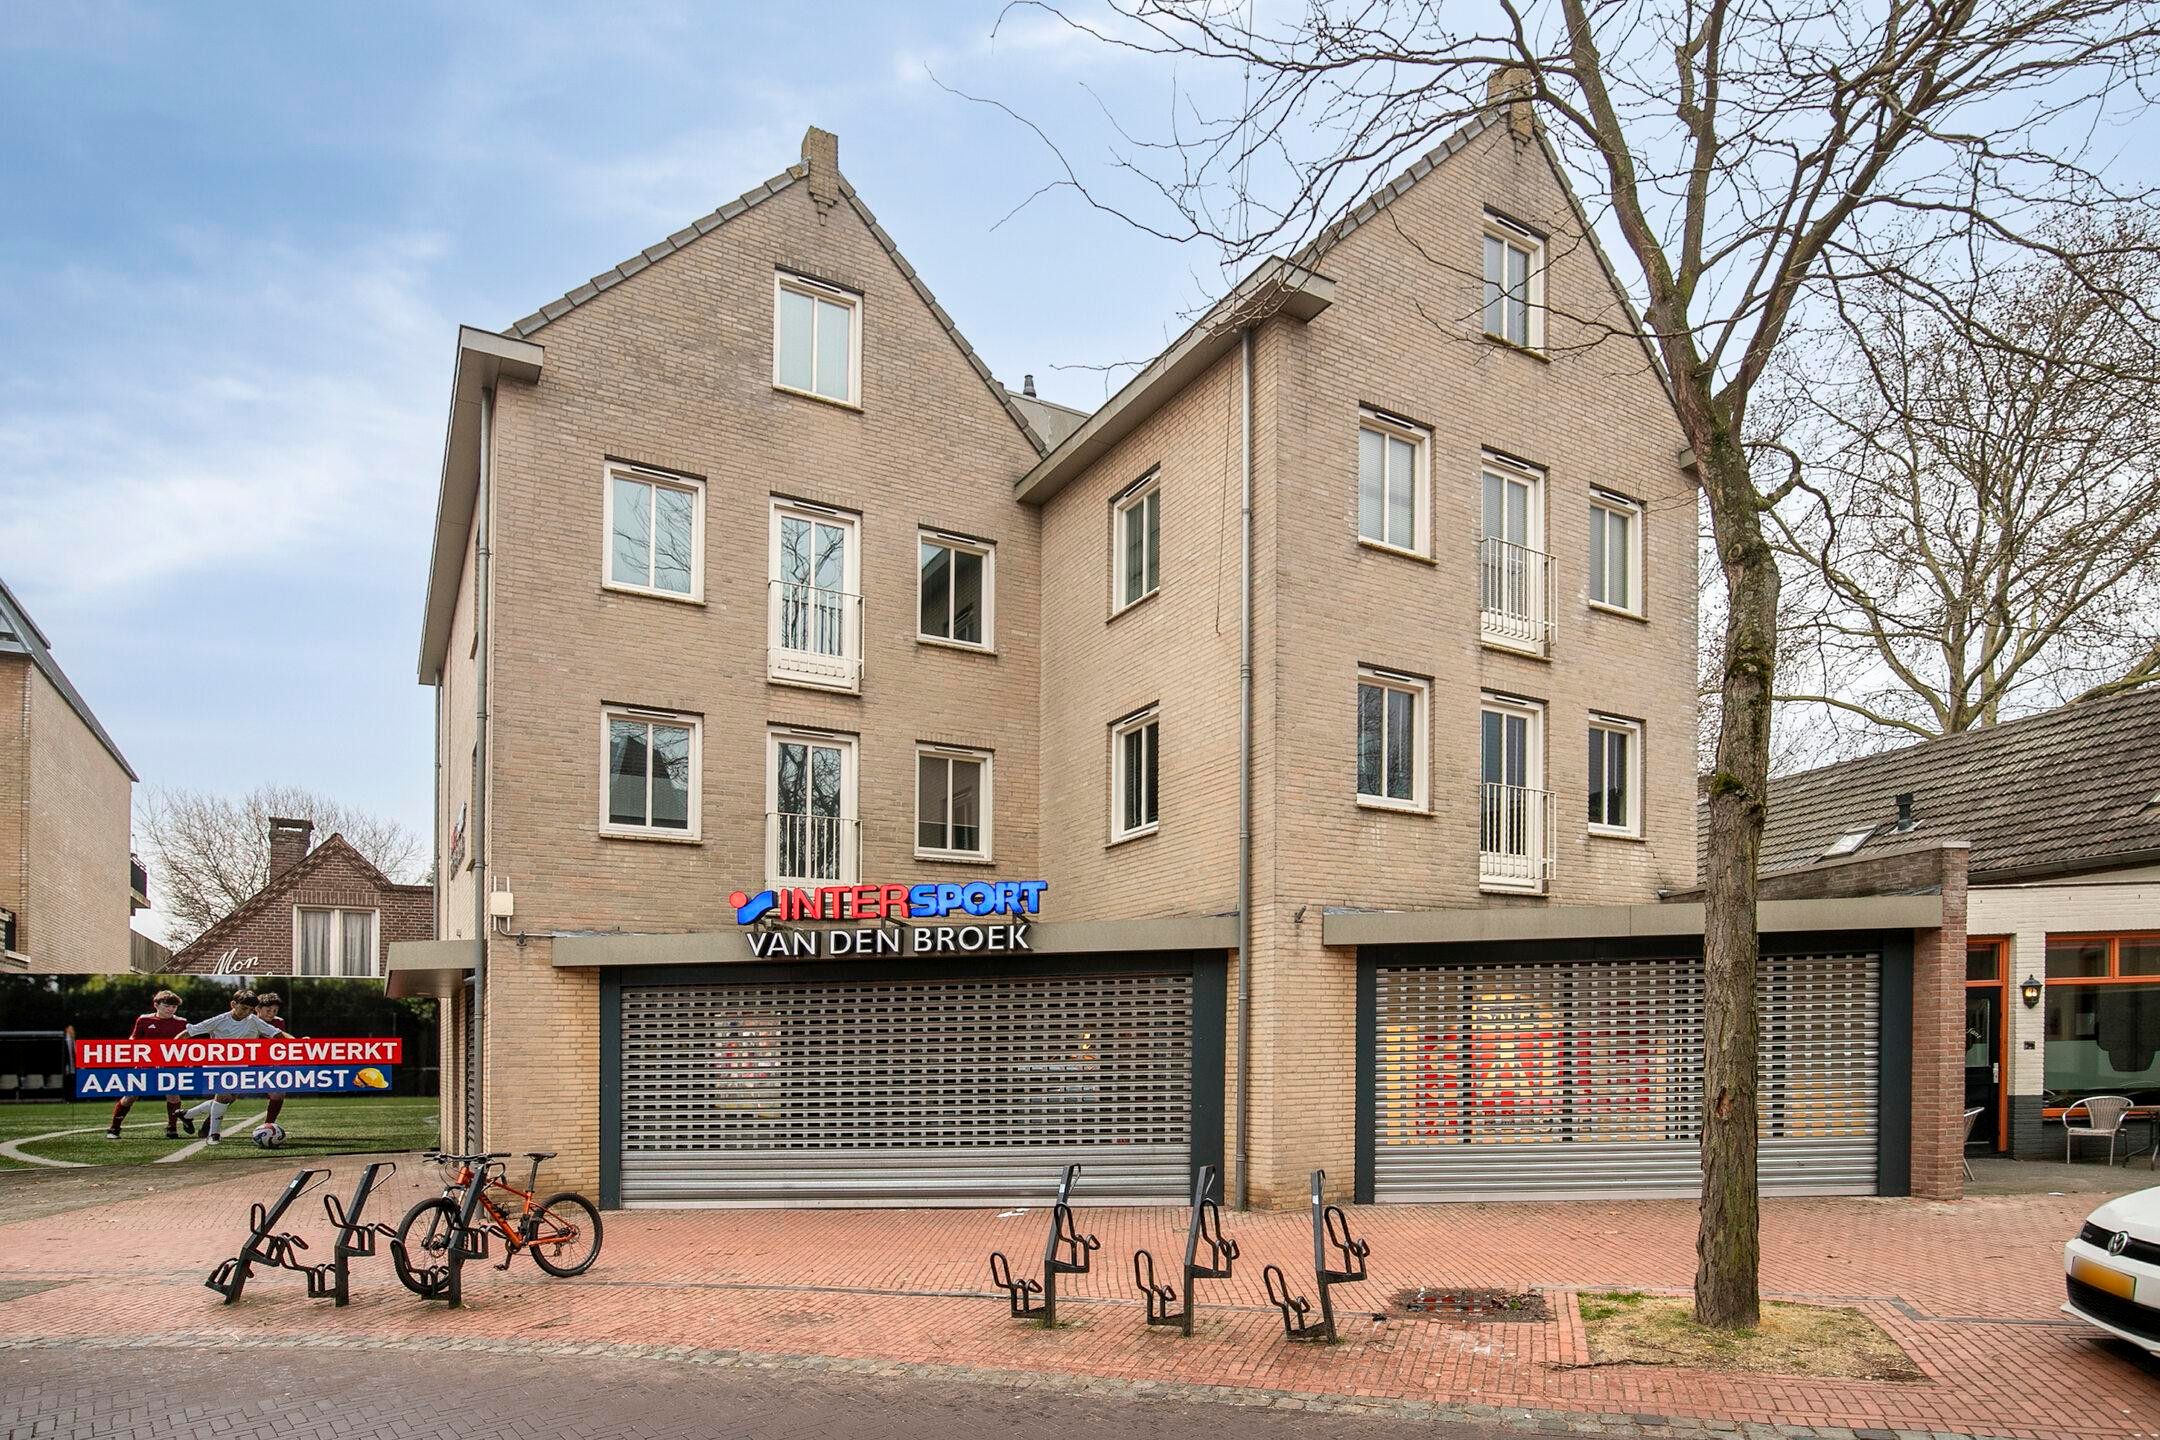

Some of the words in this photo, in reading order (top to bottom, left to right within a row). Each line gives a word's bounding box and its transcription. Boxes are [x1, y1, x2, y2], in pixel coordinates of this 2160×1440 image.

[780, 880, 1048, 921] INTERSPORT
[747, 932, 817, 957] VAN
[829, 930, 900, 955] DEN
[913, 923, 1031, 952] BROEK
[211, 948, 259, 975] Mon
[83, 1043, 152, 1064] HIER
[161, 1042, 262, 1062] WORDT
[269, 1042, 398, 1061] GEWERKT
[81, 1073, 147, 1093] AAN
[157, 1072, 194, 1091] DE
[202, 1069, 349, 1089] TOEKOMST
